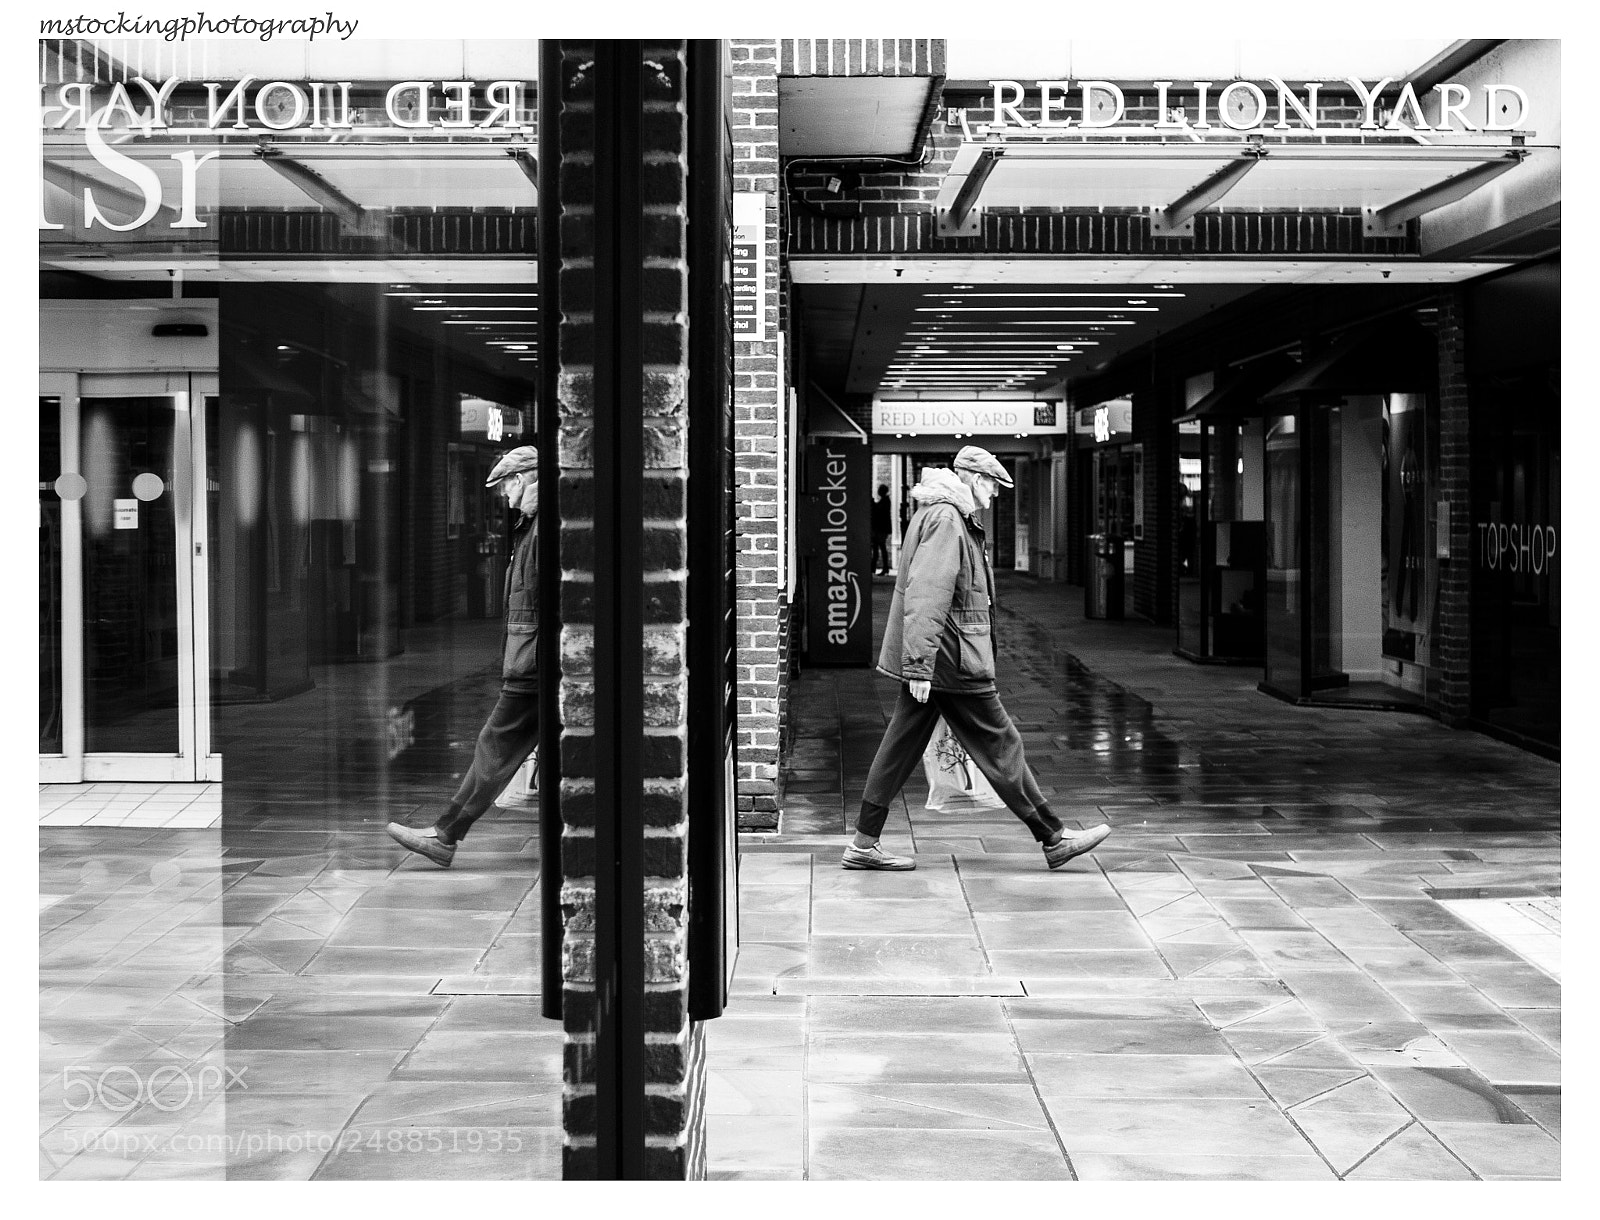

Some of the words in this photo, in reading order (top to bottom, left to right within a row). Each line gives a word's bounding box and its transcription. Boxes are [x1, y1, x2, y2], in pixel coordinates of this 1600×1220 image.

[988, 79, 1126, 130] RED
[1152, 76, 1327, 131] LION
[1346, 76, 1531, 131] YARD
[880, 411, 916, 427] RED
[921, 409, 965, 427] LION
[970, 410, 1018, 427] YARD
[818, 448, 848, 645] amazonlocker
[1477, 522, 1556, 575] TOPSHOP
